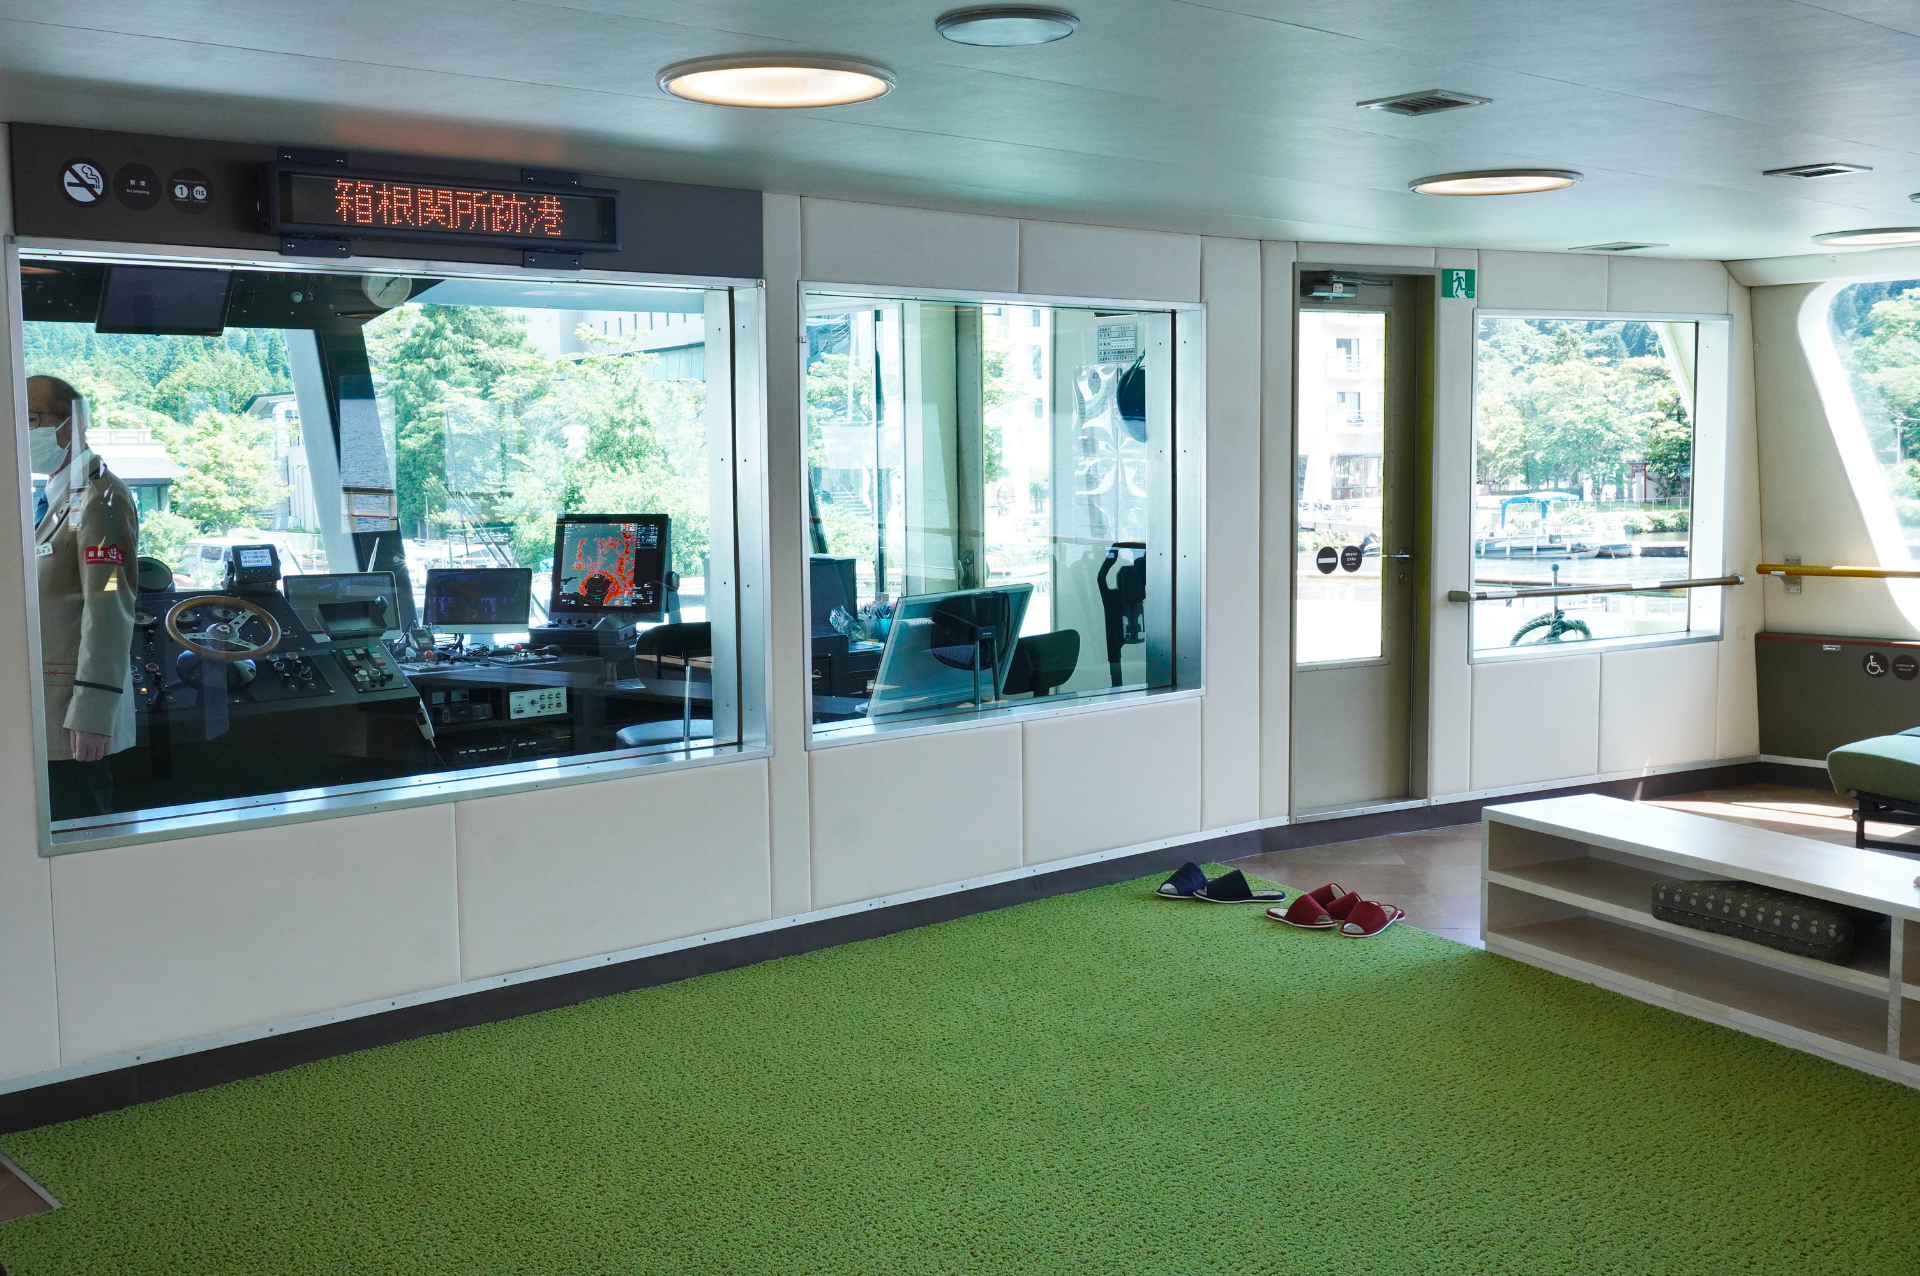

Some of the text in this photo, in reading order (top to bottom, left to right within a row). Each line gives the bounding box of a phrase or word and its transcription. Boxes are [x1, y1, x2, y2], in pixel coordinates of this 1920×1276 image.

[334, 179, 563, 236] 箱根関所跡港
